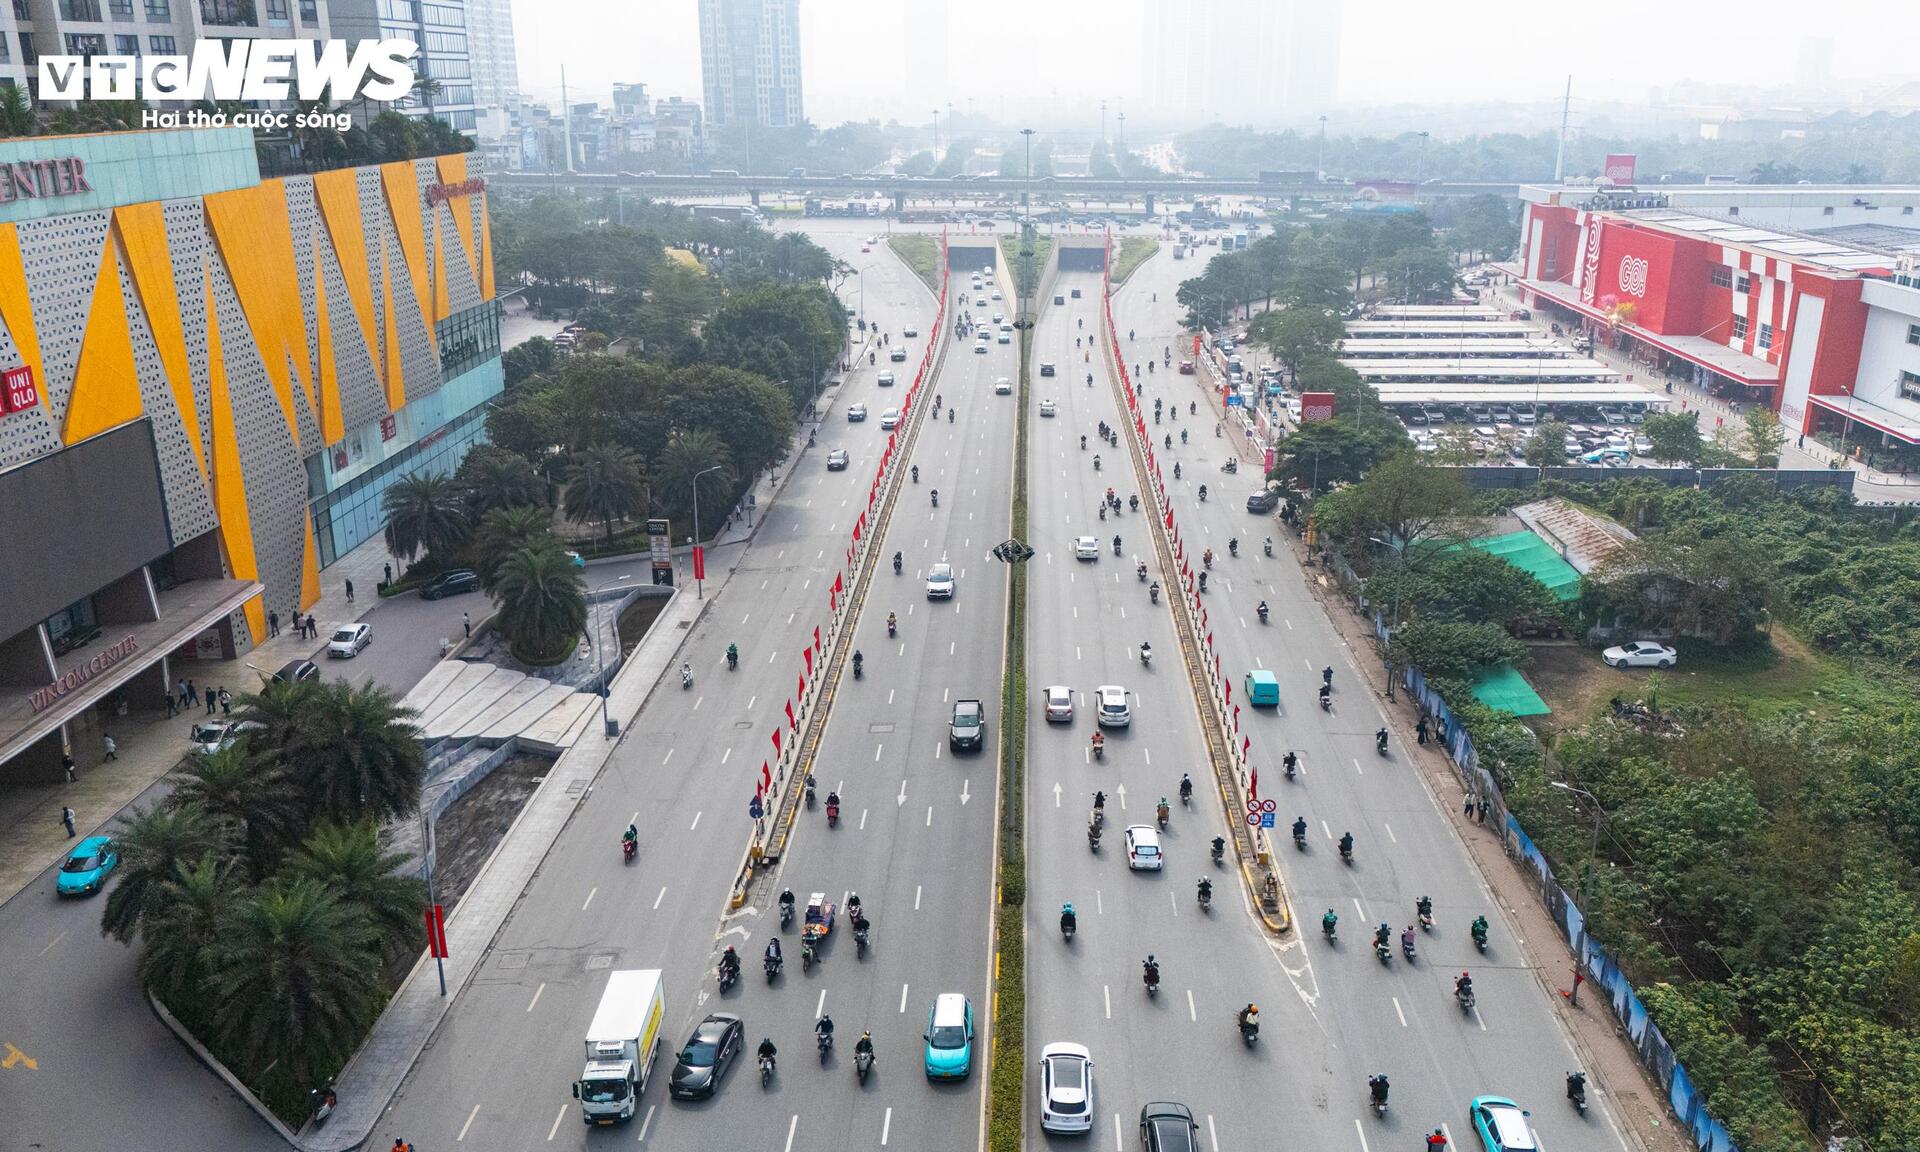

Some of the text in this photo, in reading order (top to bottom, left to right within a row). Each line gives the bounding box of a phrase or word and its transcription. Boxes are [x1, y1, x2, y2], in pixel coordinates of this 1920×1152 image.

[1618, 254, 1648, 298] GO!
[8, 371, 30, 390] UNI
[12, 388, 35, 409] QLO
[28, 634, 139, 713] VINCOM CENTER
